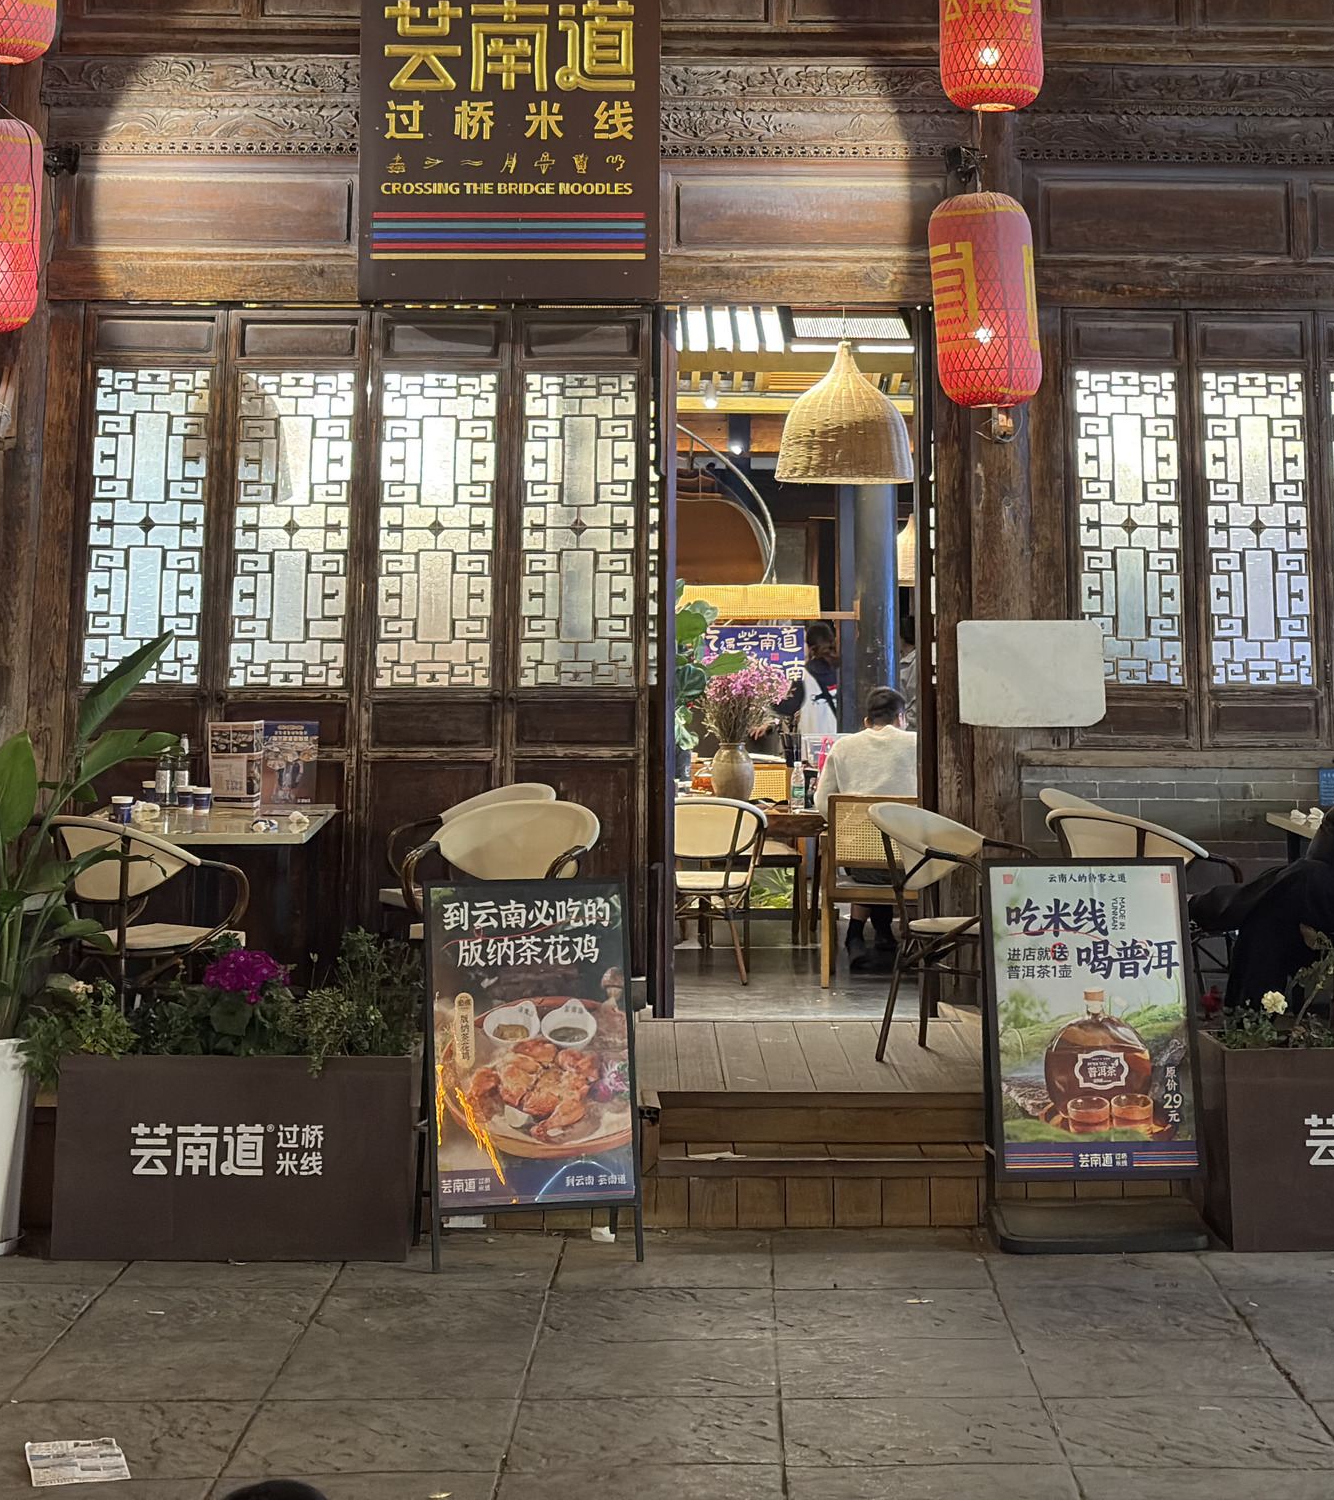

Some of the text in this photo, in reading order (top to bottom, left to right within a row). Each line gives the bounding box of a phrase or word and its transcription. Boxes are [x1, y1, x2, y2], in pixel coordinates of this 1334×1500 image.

[383, 100, 634, 141] 过桥米线
[380, 181, 633, 197] CROSSING THE BRIDGE NOODLES
[1048, 873, 1127, 884] 云南人的待客之道
[442, 897, 611, 932] 到云南必吃的
[1005, 897, 1109, 939] 吃米线
[456, 933, 600, 968] 版纳茶花鸡
[1007, 944, 1069, 961] 进店就送
[1076, 938, 1180, 980] 喝普洱
[1007, 964, 1072, 980] 普洱茶1壶
[1087, 1066, 1117, 1078] 普洱茶
[1163, 1066, 1182, 1124] 原价29元
[130, 1122, 265, 1177] 芸南道
[276, 1123, 325, 1150] 过桥
[275, 1151, 324, 1177] 米线
[1078, 1152, 1114, 1168] 芸南道
[441, 1177, 477, 1194] 芸南道
